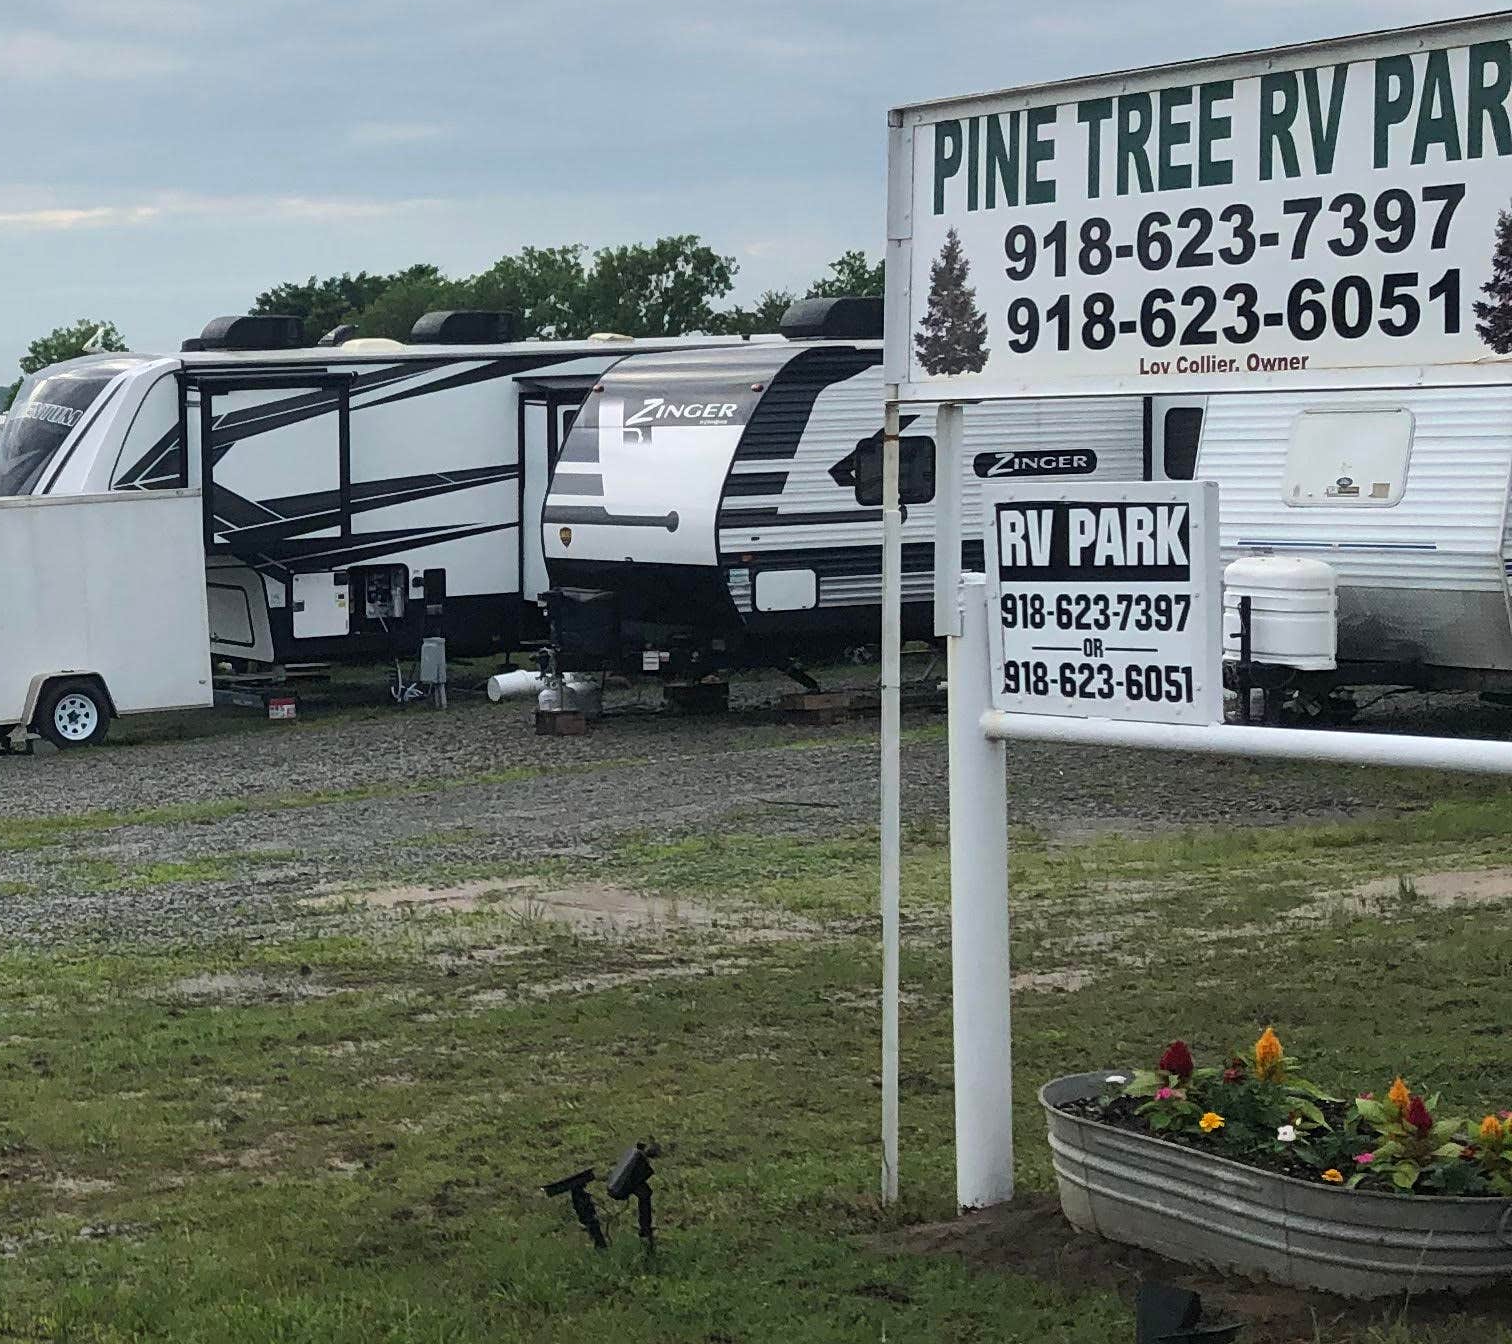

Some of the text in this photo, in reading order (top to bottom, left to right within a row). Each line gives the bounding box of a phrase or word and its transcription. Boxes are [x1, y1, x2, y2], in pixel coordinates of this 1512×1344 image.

[933, 40, 1512, 216] PINE TREE RV PAR
[1004, 183, 1466, 281] 918-623-7397
[1007, 268, 1460, 354] 918-623-6051
[1246, 353, 1310, 372] Owner
[1000, 505, 1189, 567] RV PARK
[1001, 593, 1191, 632] 918-623-7397
[1083, 638, 1104, 658] OR
[1003, 660, 1194, 703] 918-623-6051
